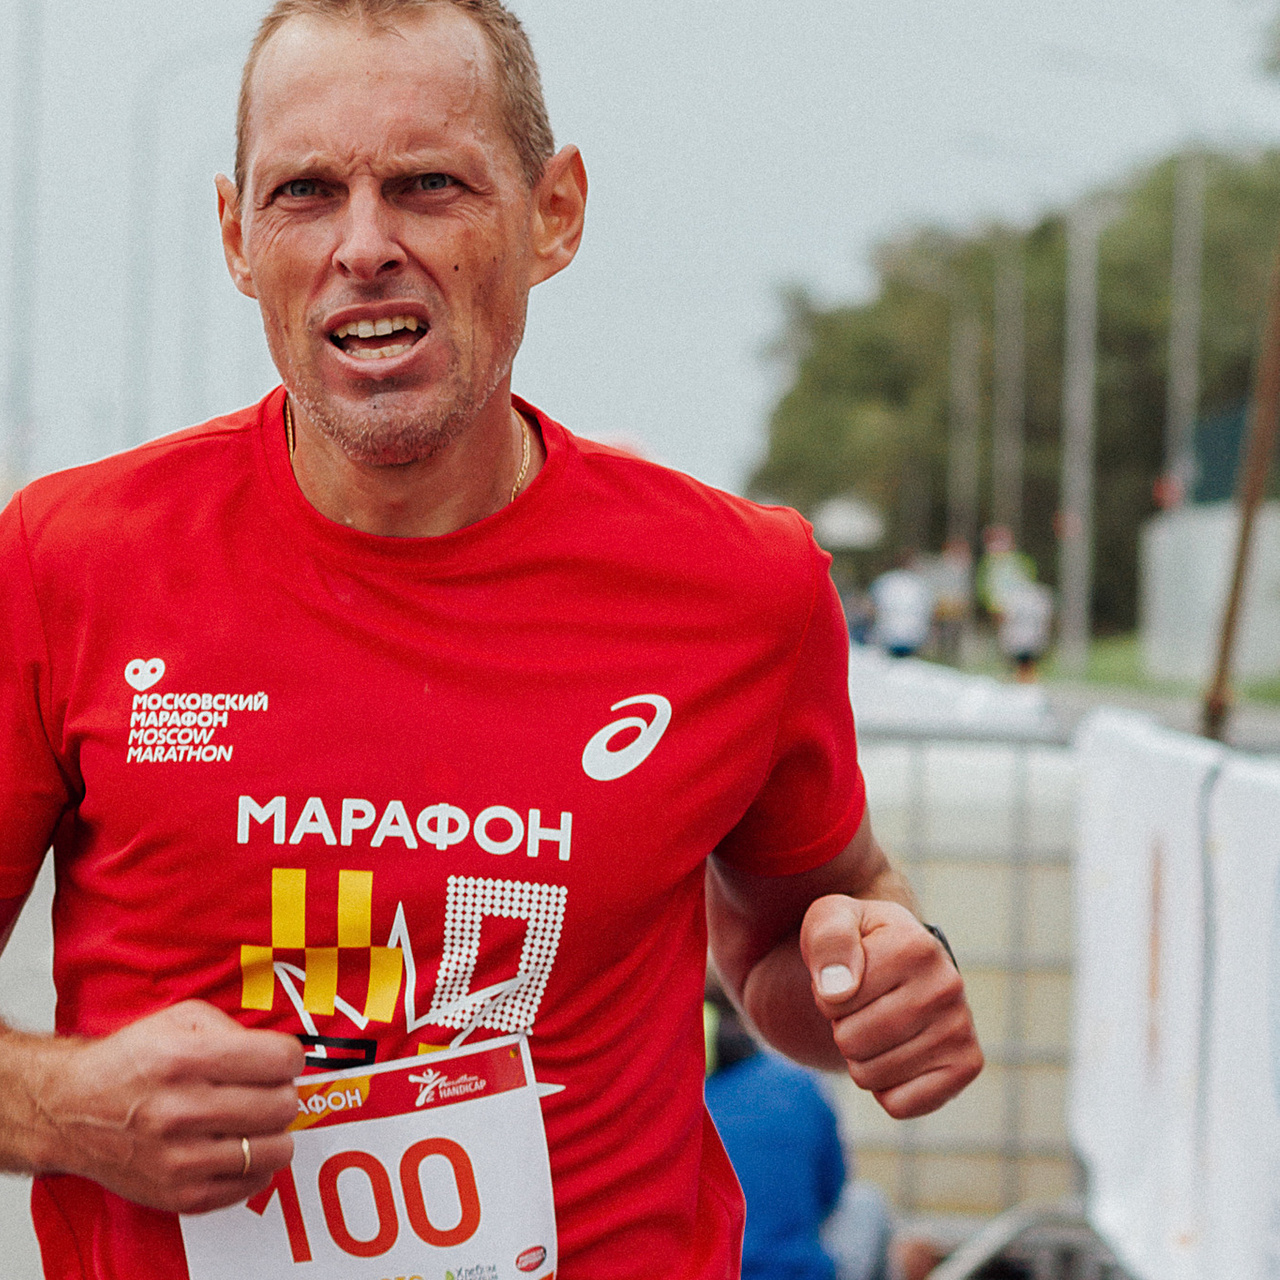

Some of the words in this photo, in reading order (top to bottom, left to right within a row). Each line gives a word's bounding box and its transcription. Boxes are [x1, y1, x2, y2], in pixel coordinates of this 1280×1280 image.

[132, 691, 269, 711] МОСКОВСКИЙ
[130, 711, 229, 728] МАРАФОН
[128, 727, 215, 746] MOSCOW
[126, 745, 234, 763] MARATHON
[236, 795, 573, 862] МАРАФОН
[439, 1079, 487, 1100] HANDICAP
[297, 1088, 363, 1115] АФОН
[245, 1137, 482, 1264] 100
